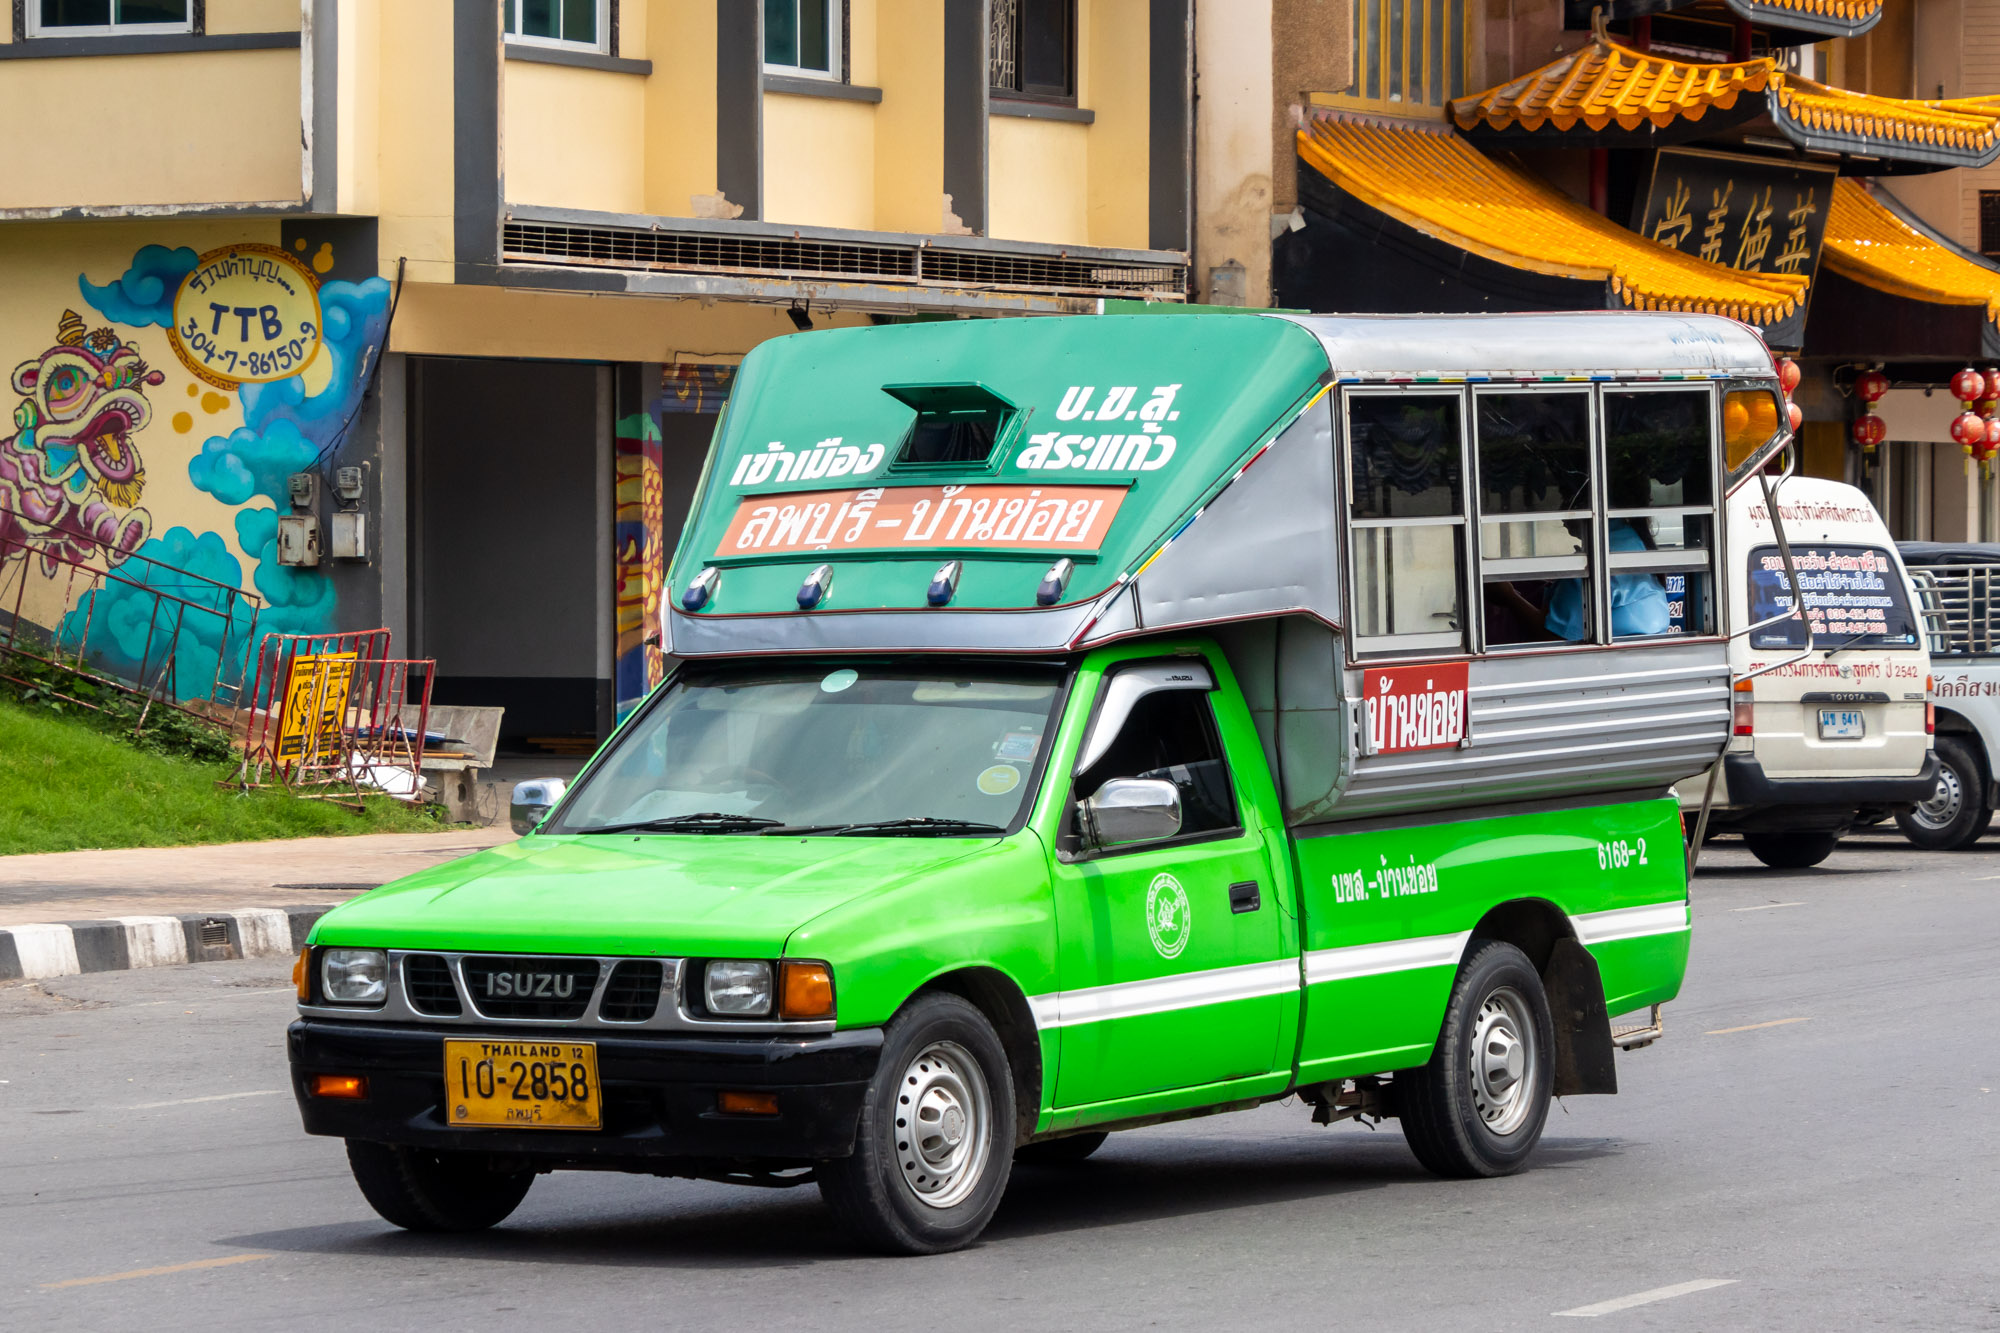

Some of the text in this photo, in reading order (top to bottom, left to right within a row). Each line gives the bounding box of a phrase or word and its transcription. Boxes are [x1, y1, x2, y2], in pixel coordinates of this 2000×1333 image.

[208, 302, 283, 343] TTB
[180, 317, 318, 376] 304-7-86150-9
[1056, 383, 1183, 422] บ.ข.ส.
[729, 437, 886, 487] เข้าเมือง
[1016, 422, 1178, 472] สระแก้ว
[1895, 665, 1918, 678] 2542
[1367, 675, 1464, 750] บ้านข่อย
[1830, 693, 1866, 701] TOYOTA
[1842, 712, 1857, 726] 641
[486, 971, 575, 999] ISUZU
[481, 1044, 584, 1059] THAILAND 12
[461, 1058, 589, 1102] 10-2858
[505, 1105, 543, 1124] ลพบุรี
